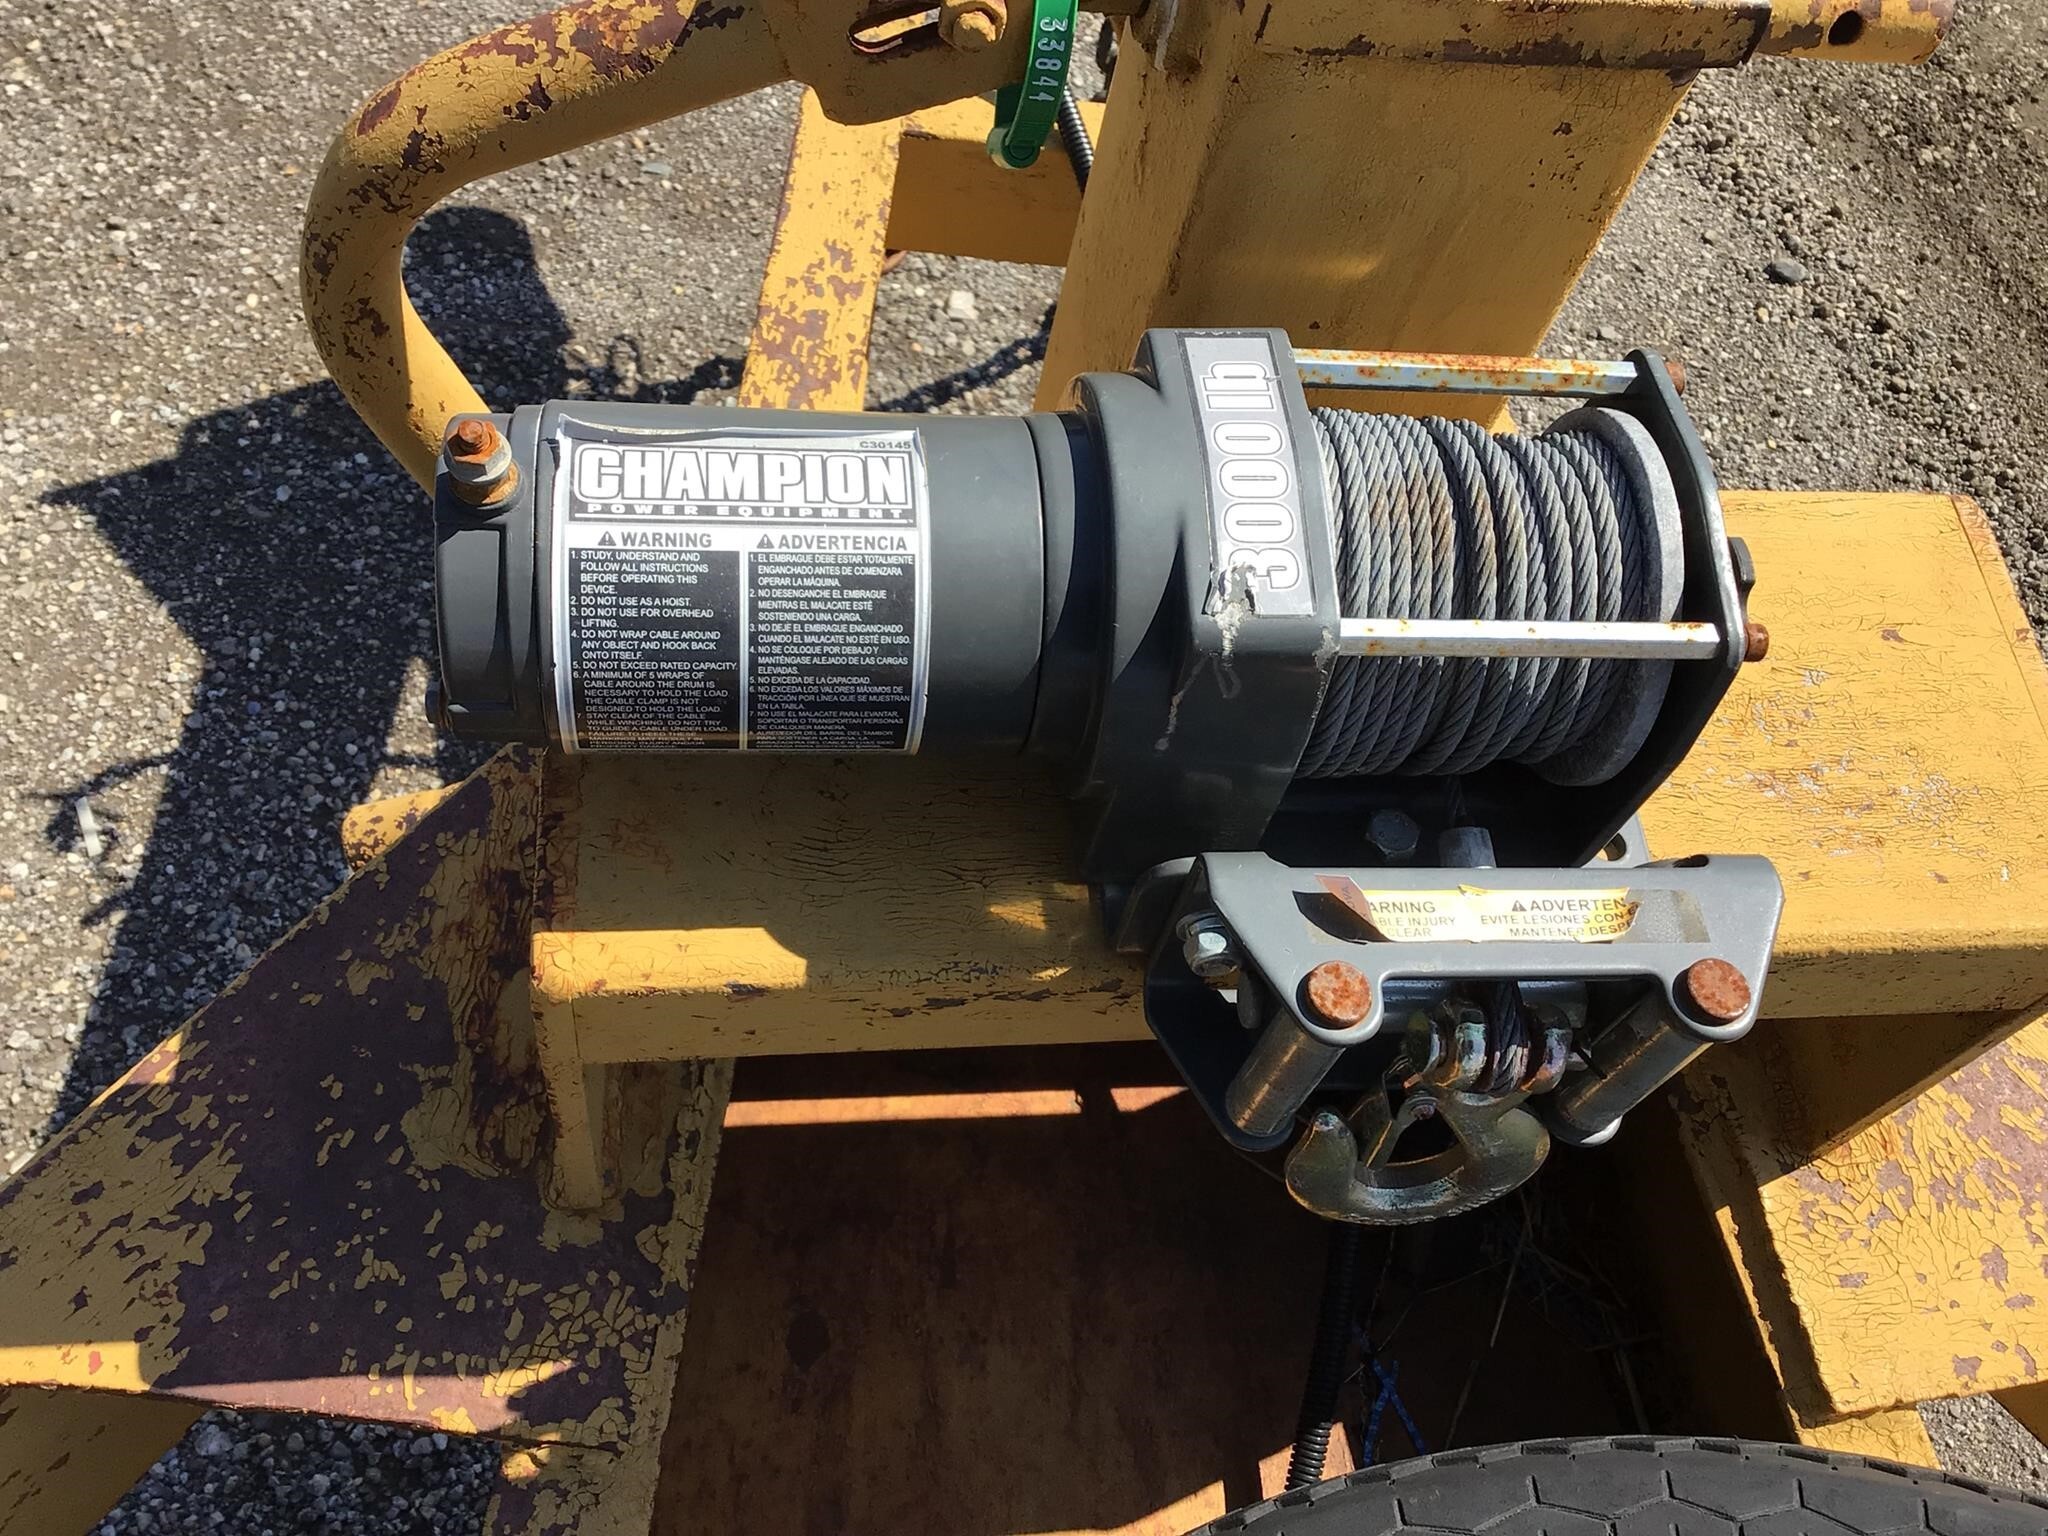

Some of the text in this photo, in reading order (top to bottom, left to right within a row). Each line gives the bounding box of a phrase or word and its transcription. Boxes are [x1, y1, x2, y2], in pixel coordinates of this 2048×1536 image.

[1029, 17, 1068, 101] 33844
[859, 440, 911, 449] C30145
[577, 445, 911, 507] CHAMPION
[1210, 420, 1300, 590] 3000
[587, 505, 905, 518] POWER EQUIPMENT
[621, 532, 712, 548] WARNING
[778, 533, 908, 551] ADVERTENCIA
[571, 551, 700, 562] 1. STUDY, UNDERSTAND AND
[750, 554, 913, 565] 1. EL EMBRAGUE DEBE ESTAR TOTALMENTE
[581, 562, 709, 572] FOLLOW ALL INSTRUCTIONS
[758, 565, 813, 575] ENGANCHADO
[814, 566, 840, 575] ANTES
[842, 566, 853, 575] DE
[581, 573, 698, 584] BEFORE OPERATING THIS
[758, 577, 791, 586] OPERAR
[792, 577, 803, 586] LA
[581, 585, 618, 594] DEVICE.
[750, 589, 887, 599] 2. NO DESENGANCHE EL EMBRAGUE
[581, 596, 595, 605] DO
[597, 597, 617, 605] NOT
[619, 597, 638, 606] USE
[639, 597, 653, 606] AS
[653, 598, 661, 606] A
[662, 598, 691, 606] HOIST.
[758, 601, 798, 610] MIENTRAS
[800, 601, 810, 610] EL
[811, 601, 852, 610] MALACATE
[571, 608, 714, 618] 3. DO NOT USE FOR OVERHEAD
[758, 612, 862, 622] SOSTENIENDO UNA CARGA.
[581, 619, 619, 628] LIFTING.
[750, 623, 904, 633] 3. NO DEJE EL EMBRAGUE ENGANCHADO
[571, 630, 721, 640] 4. DO NOT WRAP CABLE AROUND
[758, 634, 791, 643] CUANDO
[793, 635, 803, 643] EL
[804, 635, 844, 644] MALACATE
[846, 635, 858, 644] NO
[880, 635, 892, 644] EN
[893, 635, 911, 645] USO.
[581, 641, 716, 650] ANY OBJECT AND HOOK BACK
[582, 651, 644, 659] ONTO ITSELF.
[583, 661, 597, 669] DO
[621, 662, 659, 670] EXCEED
[661, 662, 691, 670] RATED
[692, 662, 738, 670] CAPACITY.
[812, 656, 847, 665] ALEJADO
[848, 656, 860, 665] DE
[861, 656, 875, 665] LAS
[877, 656, 909, 665] CARGAS
[758, 666, 800, 675] ELEVADAS.
[1369, 901, 1436, 913] ARNING
[1530, 897, 1627, 912] ADVERTEN
[1408, 916, 1456, 927] INJURY
[1480, 911, 1625, 925] EVITE LESIONES CON
[1388, 927, 1432, 937] CLEAR
